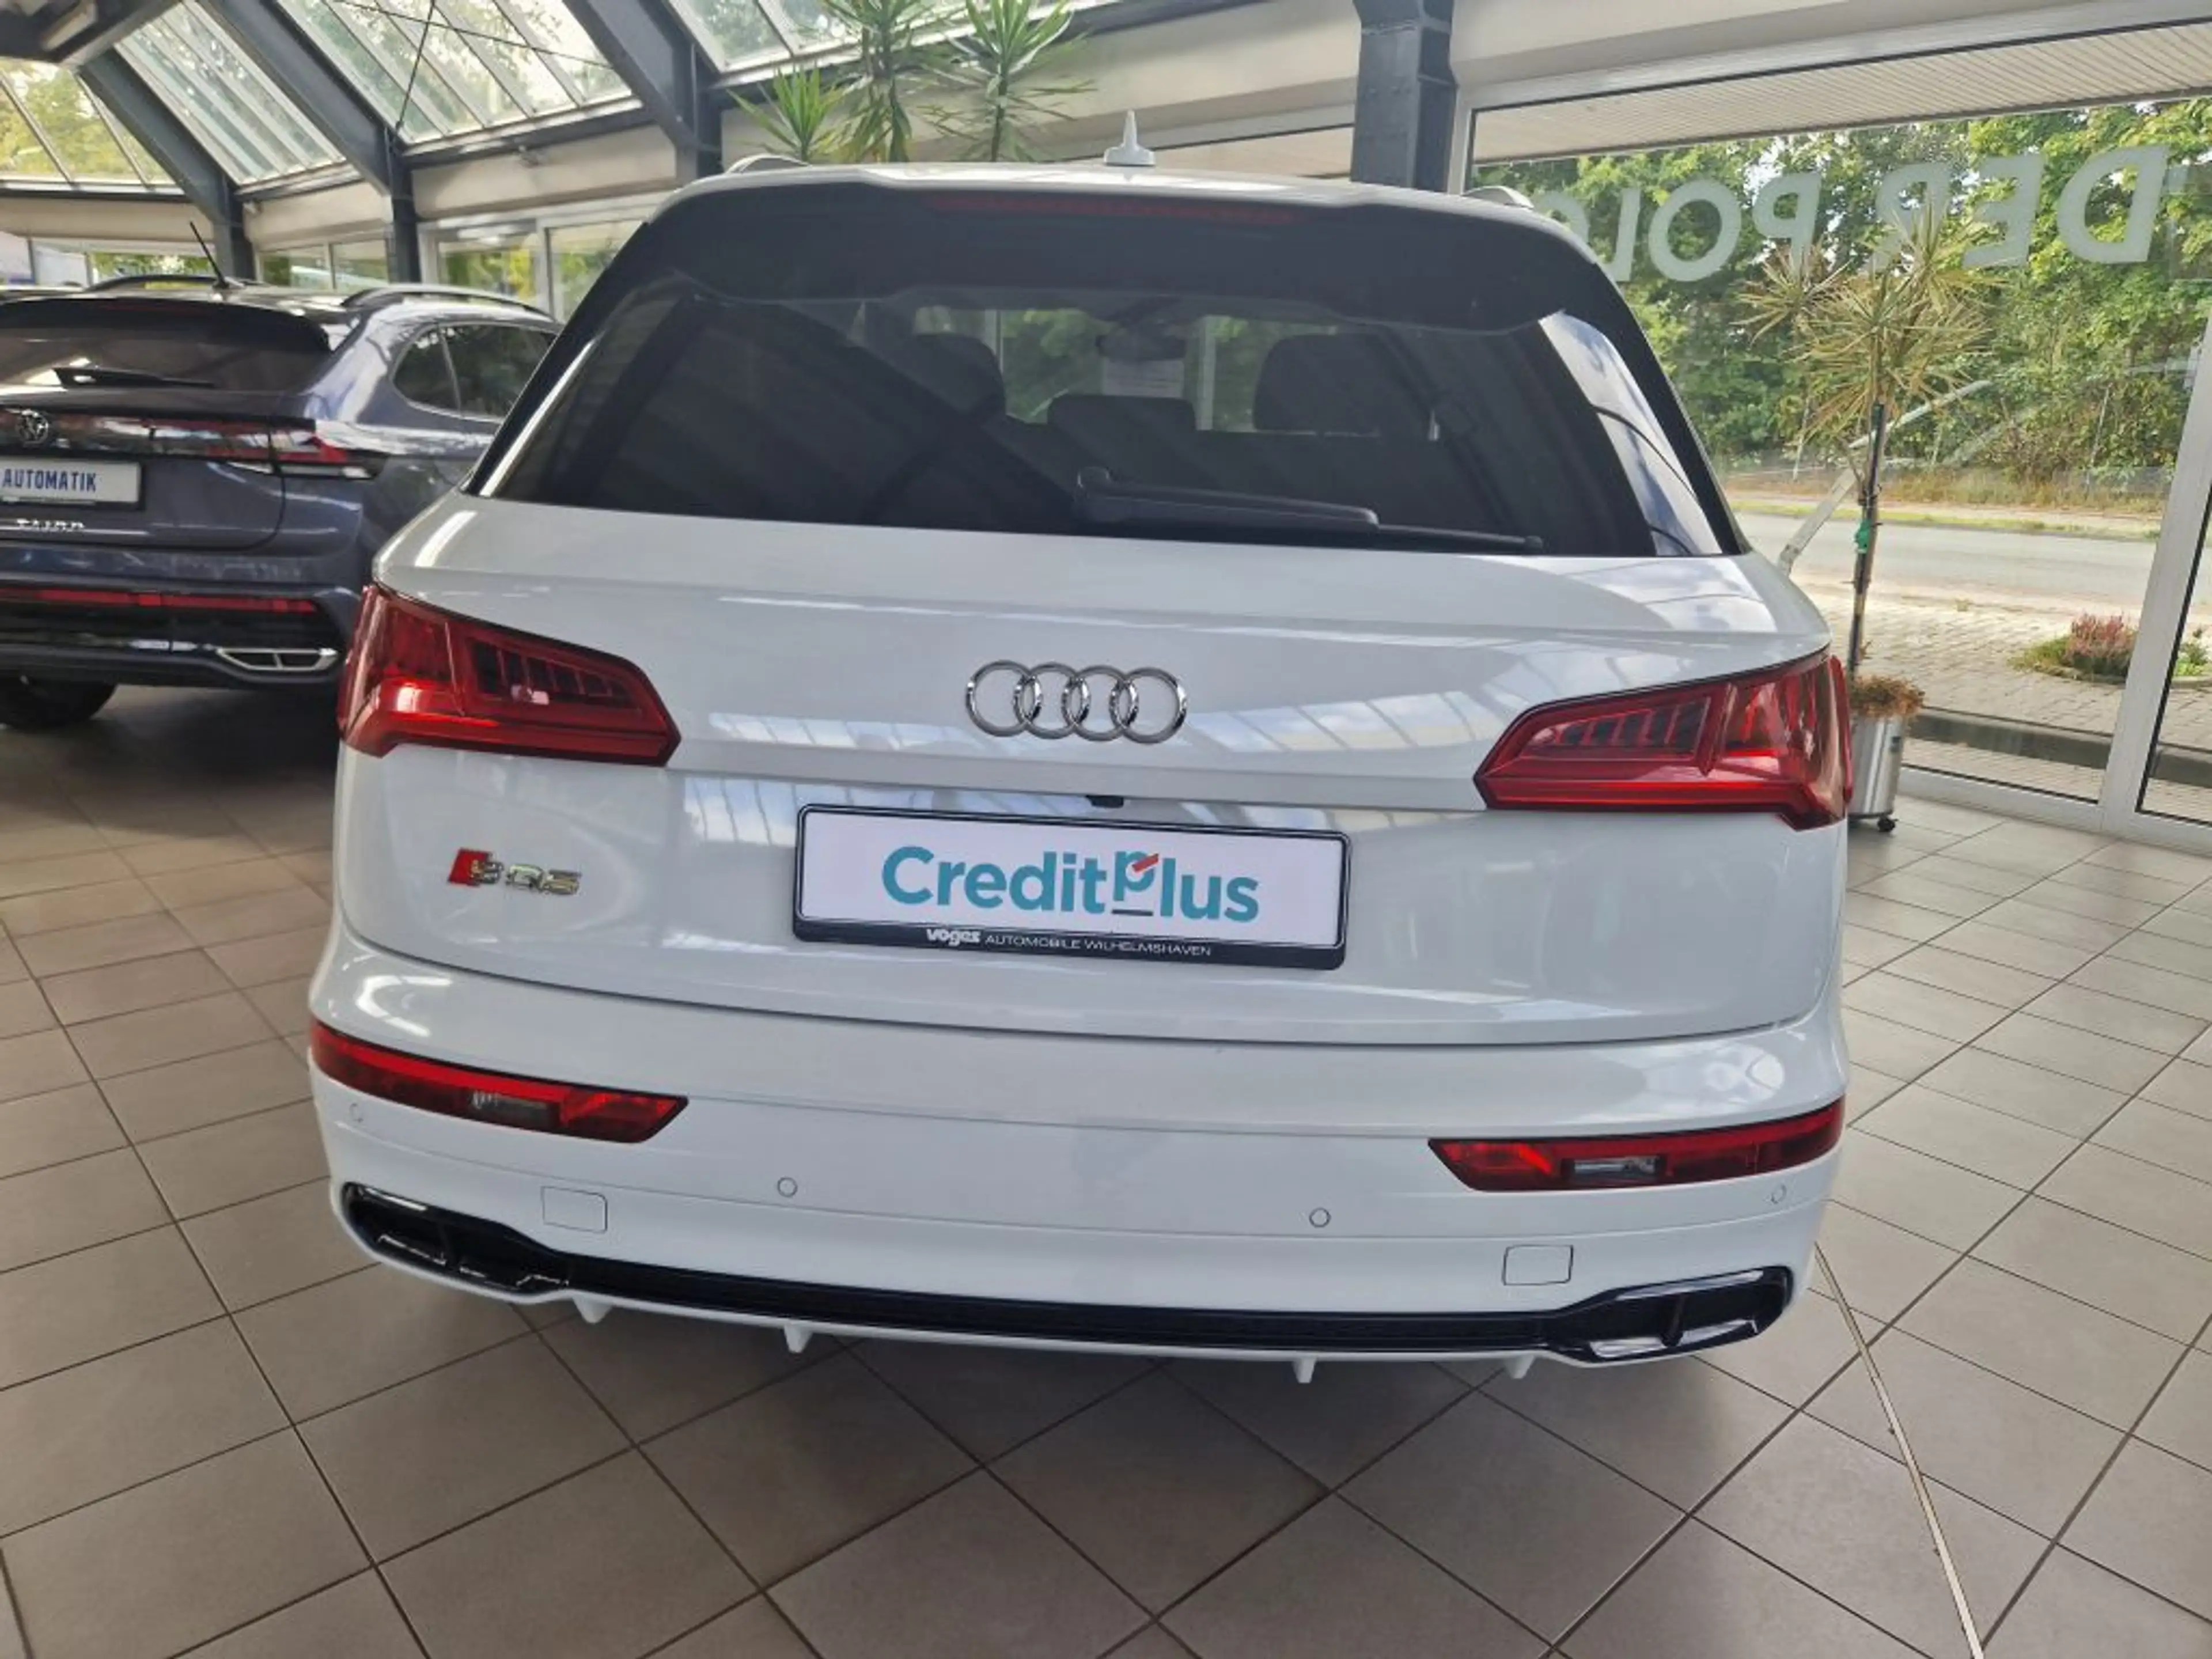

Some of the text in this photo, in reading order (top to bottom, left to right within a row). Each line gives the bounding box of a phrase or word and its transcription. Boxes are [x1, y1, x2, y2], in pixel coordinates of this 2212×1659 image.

[2, 468, 97, 492] AUTOMATIK
[882, 846, 1259, 923] CreditPlus
[926, 929, 1211, 956] voges AUTOMOBILE WILHELMSHAVEN
